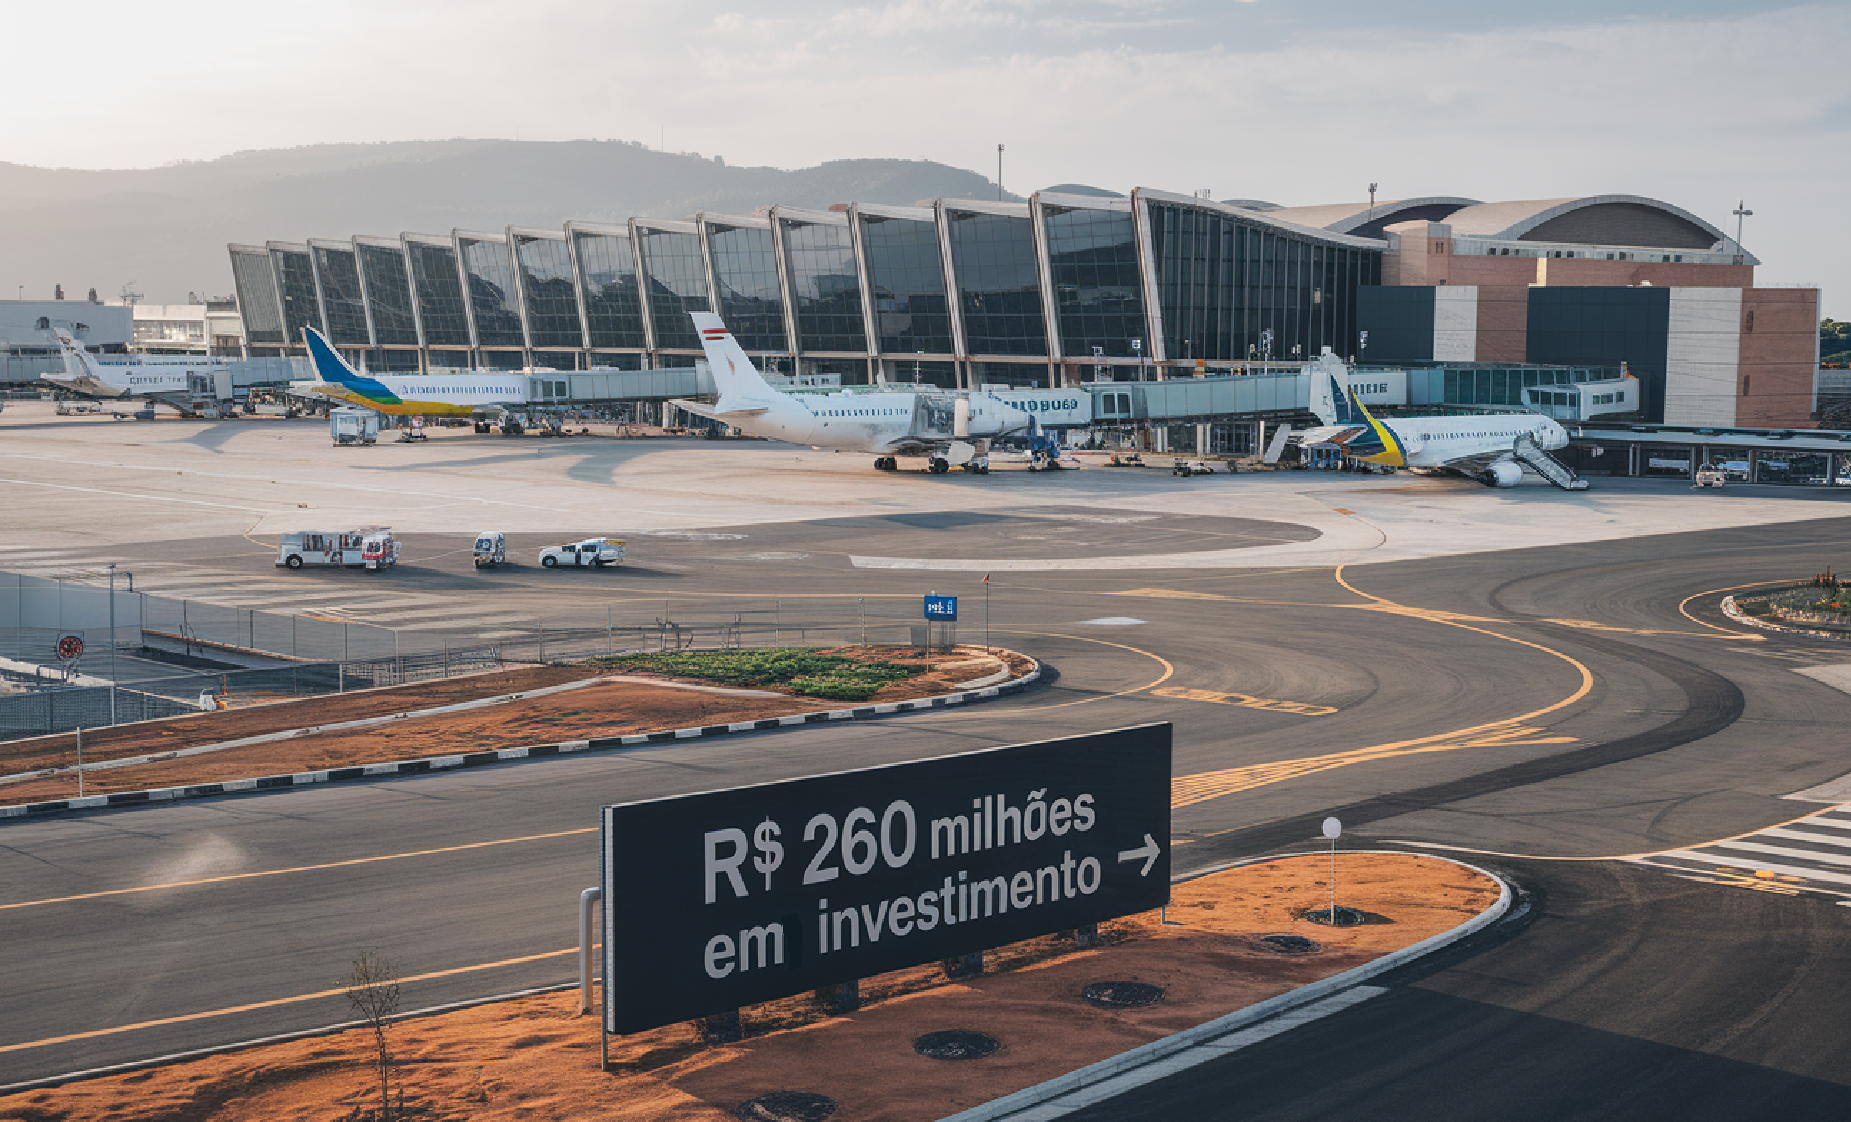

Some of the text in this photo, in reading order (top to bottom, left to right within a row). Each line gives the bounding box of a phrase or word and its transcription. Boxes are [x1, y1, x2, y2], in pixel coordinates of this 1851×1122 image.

[704, 787, 1096, 905] R$ 260 milhões
[704, 856, 1101, 979] em investimento
